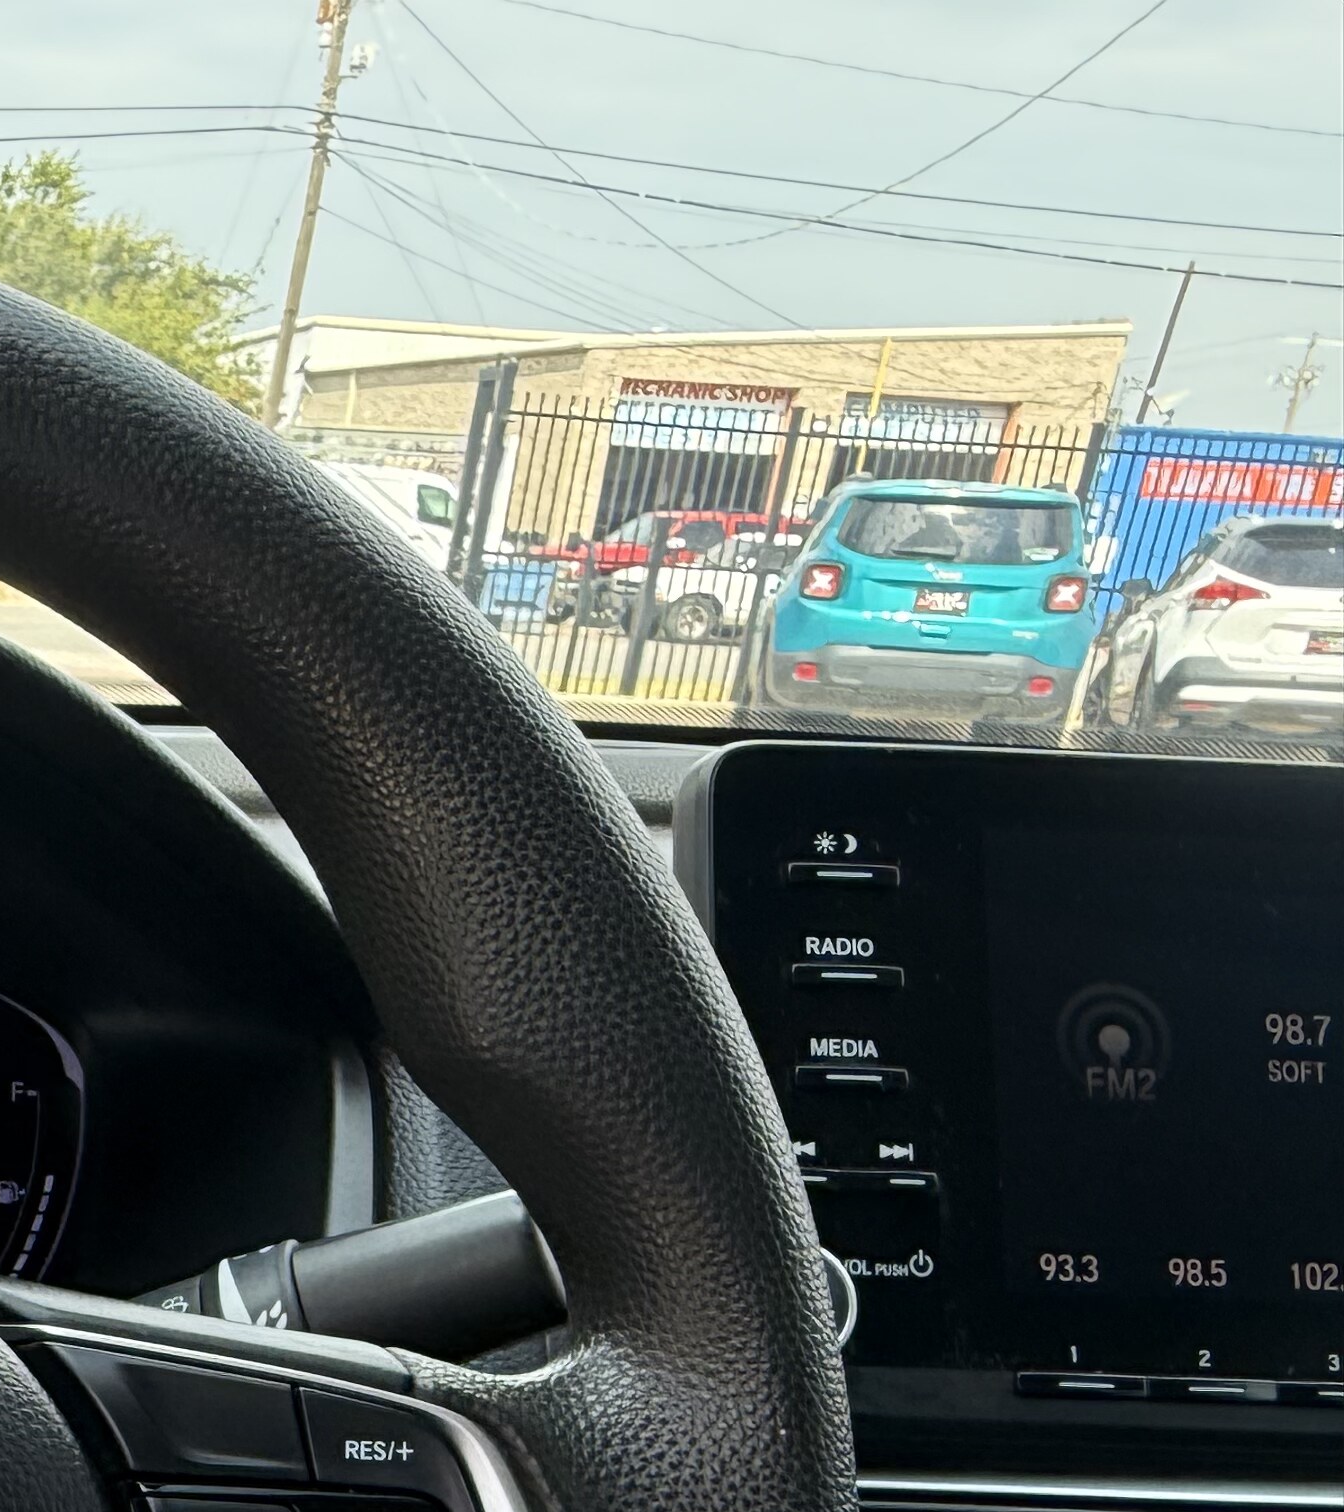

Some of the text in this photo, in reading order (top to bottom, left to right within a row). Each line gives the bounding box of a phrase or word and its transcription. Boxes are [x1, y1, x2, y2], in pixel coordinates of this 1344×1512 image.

[805, 936, 874, 957] RADIO
[1264, 1013, 1332, 1047] 98.7
[810, 1037, 879, 1058] MEDIA
[1267, 1059, 1327, 1084] SOFT
[1086, 1065, 1157, 1100] FM2
[874, 1263, 909, 1277] PUSH
[1038, 1252, 1099, 1284] 93.3
[1167, 1257, 1228, 1288] 98.5
[1070, 1345, 1078, 1363] 1
[1198, 1350, 1212, 1367] 2
[1328, 1353, 1340, 1372] 3
